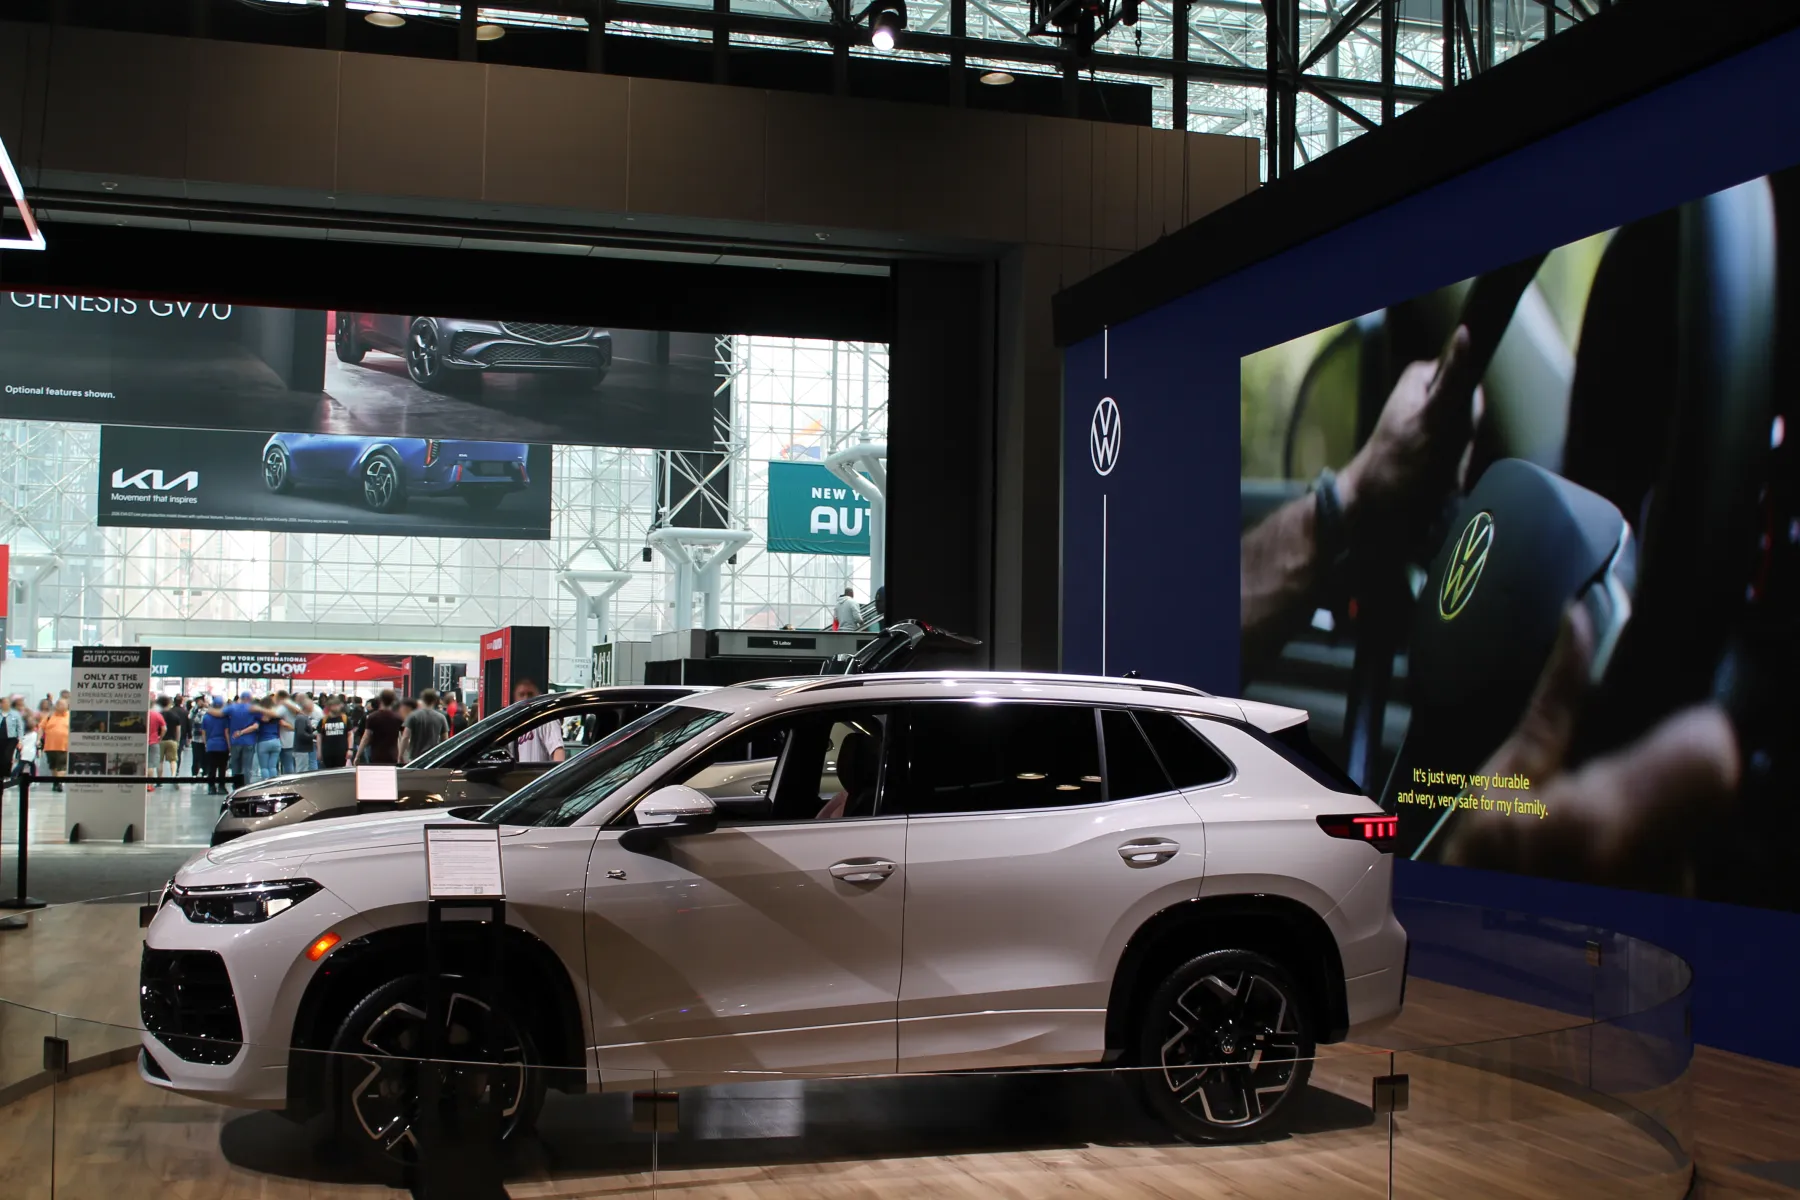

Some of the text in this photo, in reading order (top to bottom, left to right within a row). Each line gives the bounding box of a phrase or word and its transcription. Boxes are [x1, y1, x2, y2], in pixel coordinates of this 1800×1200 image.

[11, 292, 138, 315] GENESIS
[5, 385, 116, 399] Optional features shown.
[112, 468, 198, 491] KIA
[111, 492, 198, 504] Movement that inspires
[811, 487, 847, 500] NEW
[83, 655, 140, 663] AUTO SHOW
[151, 664, 169, 674] XIT
[221, 663, 306, 675] AUTO SHOW
[1413, 768, 1530, 791] It's just very, very durable
[1397, 790, 1548, 819] and very, very safe for my family.
